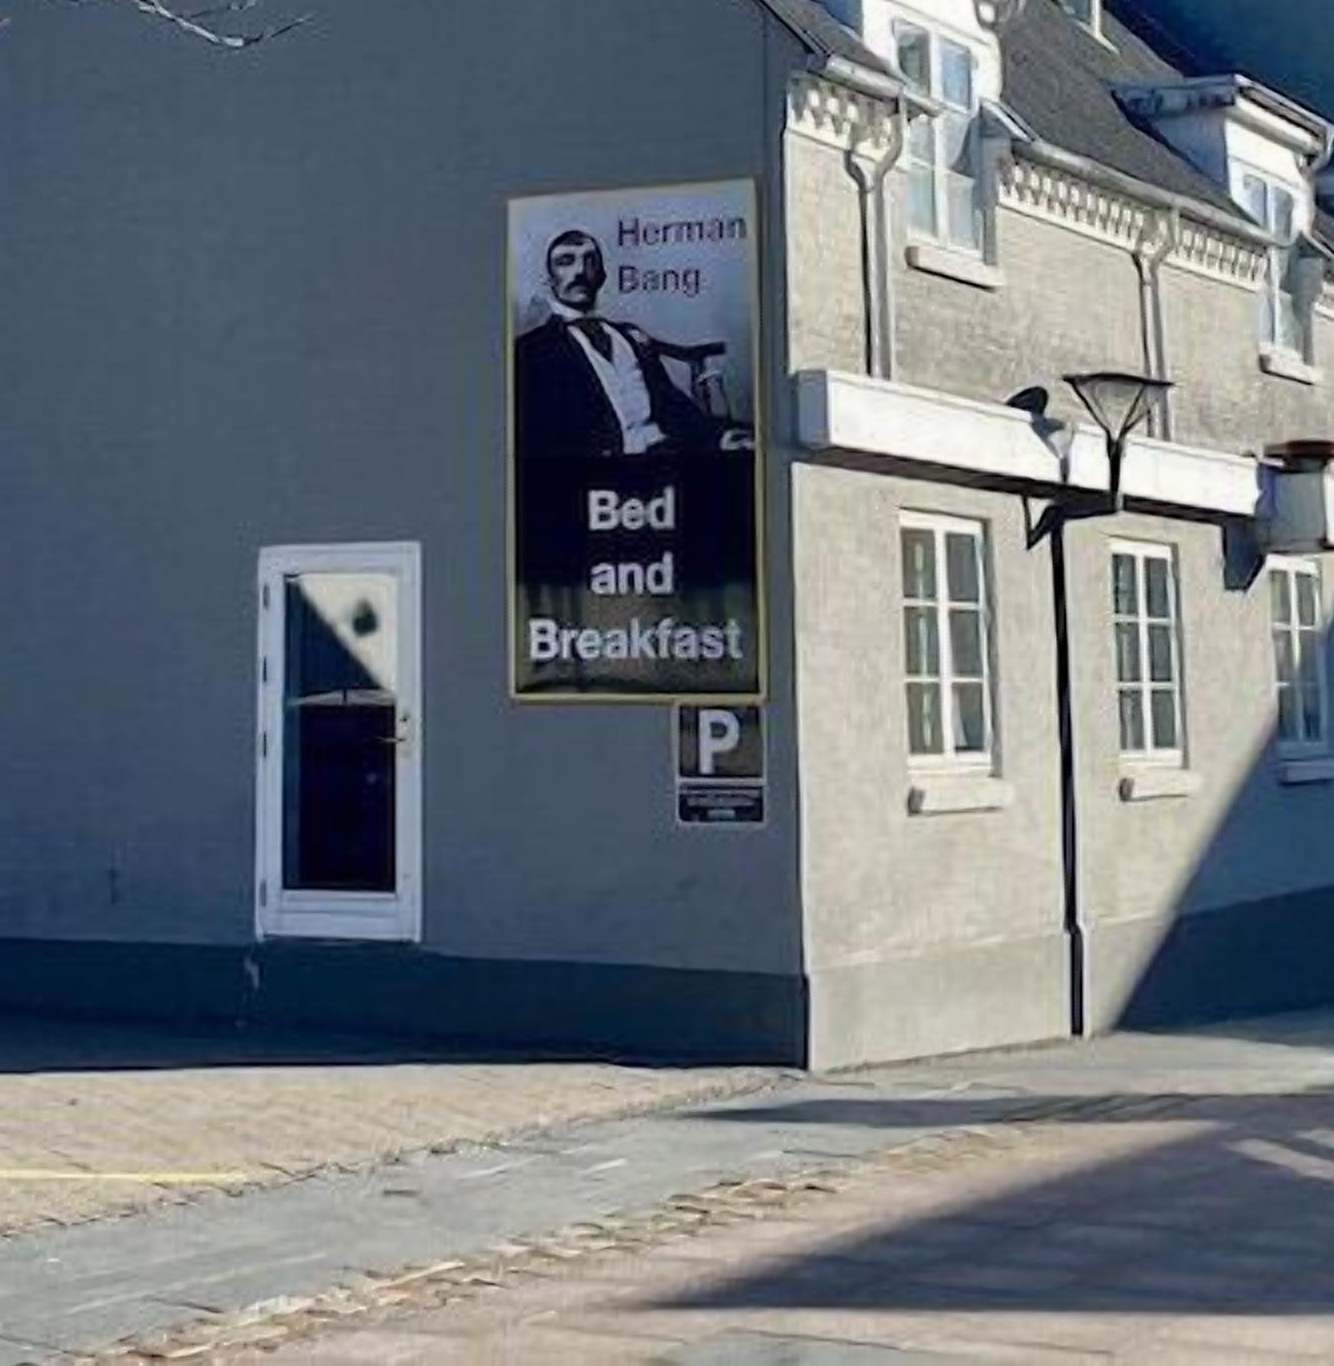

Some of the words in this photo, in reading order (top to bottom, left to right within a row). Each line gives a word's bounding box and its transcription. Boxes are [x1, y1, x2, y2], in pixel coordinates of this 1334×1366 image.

[618, 217, 747, 246] Herman
[618, 265, 700, 298] Bang
[588, 486, 675, 530] Bed
[590, 551, 674, 595] and
[529, 617, 743, 660] Breakfast
[698, 709, 740, 775] P
